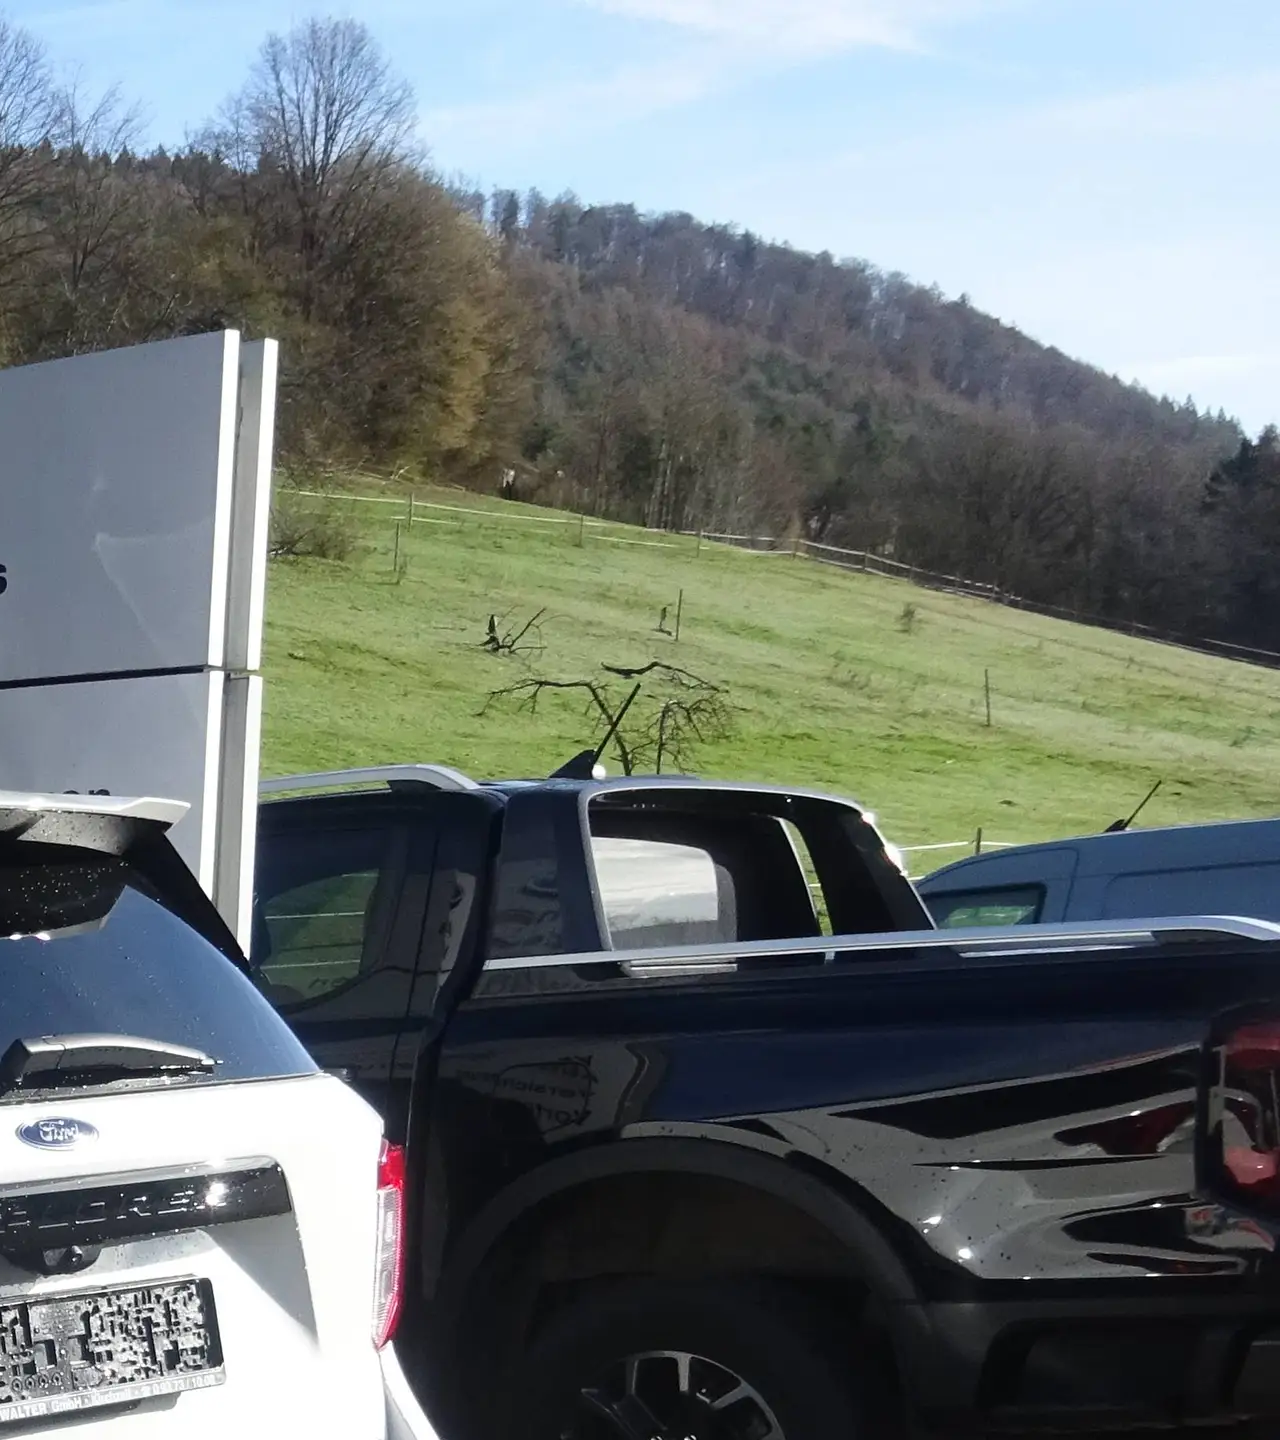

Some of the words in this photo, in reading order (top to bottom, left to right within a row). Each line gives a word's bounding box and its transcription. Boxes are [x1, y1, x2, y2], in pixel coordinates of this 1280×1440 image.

[39, 1120, 79, 1141] Ford
[0, 1404, 48, 1422] WALTER
[51, 1396, 82, 1413] GmbH
